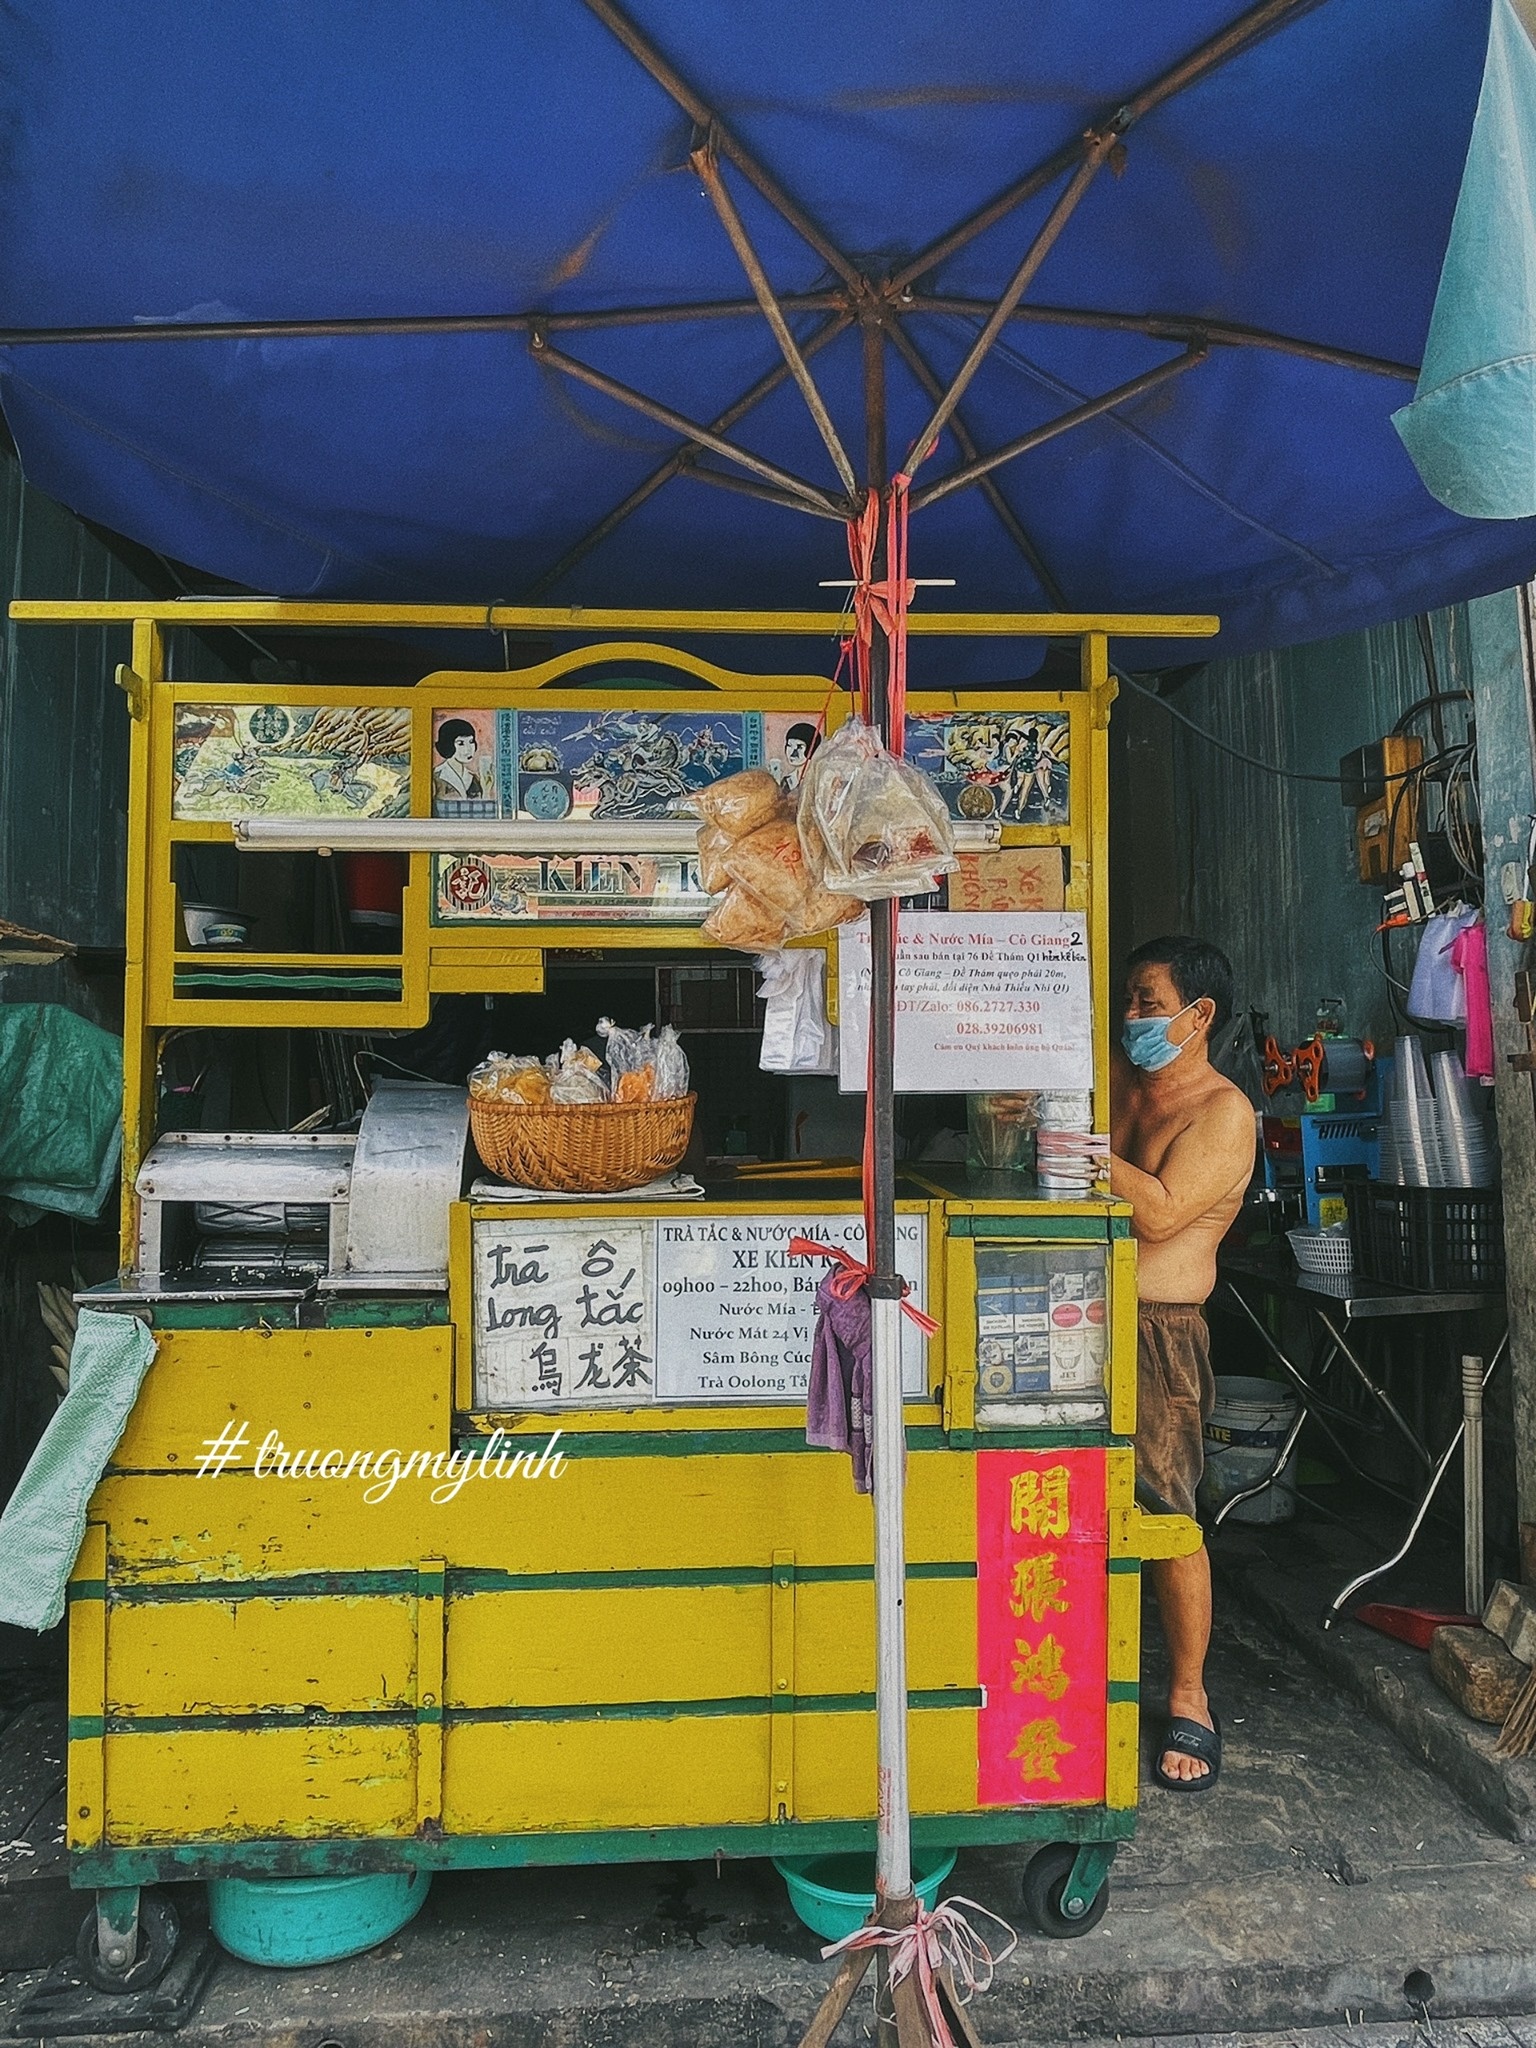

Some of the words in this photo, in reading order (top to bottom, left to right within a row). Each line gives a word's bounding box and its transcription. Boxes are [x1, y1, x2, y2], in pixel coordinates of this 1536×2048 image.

[957, 853, 988, 910] KHÔN
[912, 932, 924, 944] &
[929, 931, 964, 945] Nước
[968, 932, 994, 945] Mía
[1008, 932, 1027, 946] Cô
[1031, 932, 1070, 949] Giang
[913, 952, 930, 961] sau
[932, 951, 950, 961] bán
[967, 952, 979, 961] 76
[900, 983, 915, 993] tay
[956, 1000, 1041, 1013] 086.2727.330
[956, 1022, 1044, 1036] 028.39206981
[663, 1223, 695, 1242] TRÀ
[697, 1222, 728, 1242] TẮC
[731, 1226, 743, 1242] &
[745, 1223, 797, 1242] NƯỚC
[800, 1223, 831, 1242] MÍA
[842, 1222, 865, 1242] CÔ
[732, 1250, 759, 1269] XE
[662, 1277, 716, 1297] 09h00
[732, 1277, 788, 1295] 22h00,
[486, 1297, 563, 1339] long
[719, 1303, 763, 1316] Nước
[767, 1303, 796, 1316] Mía
[689, 1327, 734, 1340] Nước
[738, 1327, 768, 1340] Mát
[772, 1330, 789, 1342] 24
[793, 1326, 808, 1342] Vị
[702, 1351, 734, 1364] Sâm
[740, 1351, 779, 1367] Bông
[783, 1350, 812, 1364] Cúc
[698, 1374, 724, 1388] Trà
[728, 1375, 786, 1392] Oolong
